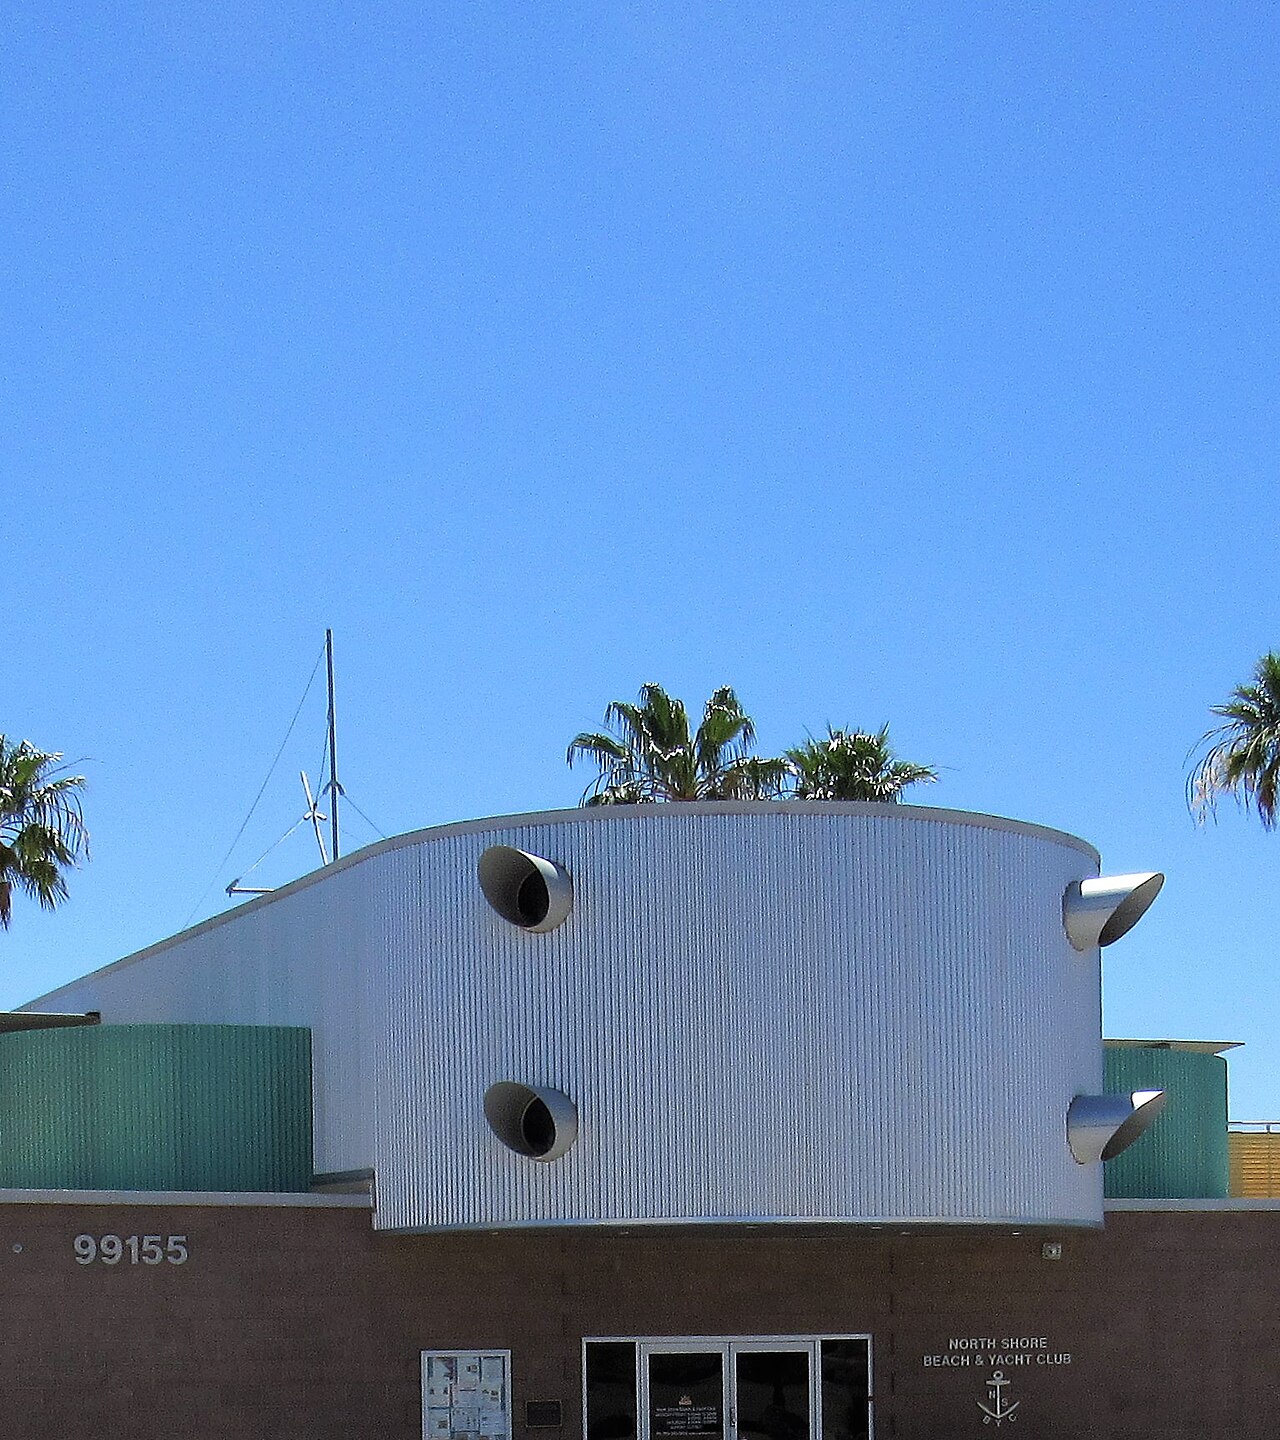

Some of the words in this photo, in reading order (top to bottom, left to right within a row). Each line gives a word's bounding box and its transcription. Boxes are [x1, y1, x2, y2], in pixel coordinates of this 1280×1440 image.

[73, 1234, 188, 1265] 99155
[949, 1338, 996, 1350] NORTH
[1001, 1337, 1047, 1349] SHORE
[923, 1355, 970, 1367] BEACH
[974, 1354, 984, 1366] &
[989, 1354, 1033, 1366] YACHT
[1036, 1353, 1071, 1365] CLUB
[1001, 1398, 1009, 1407] S
